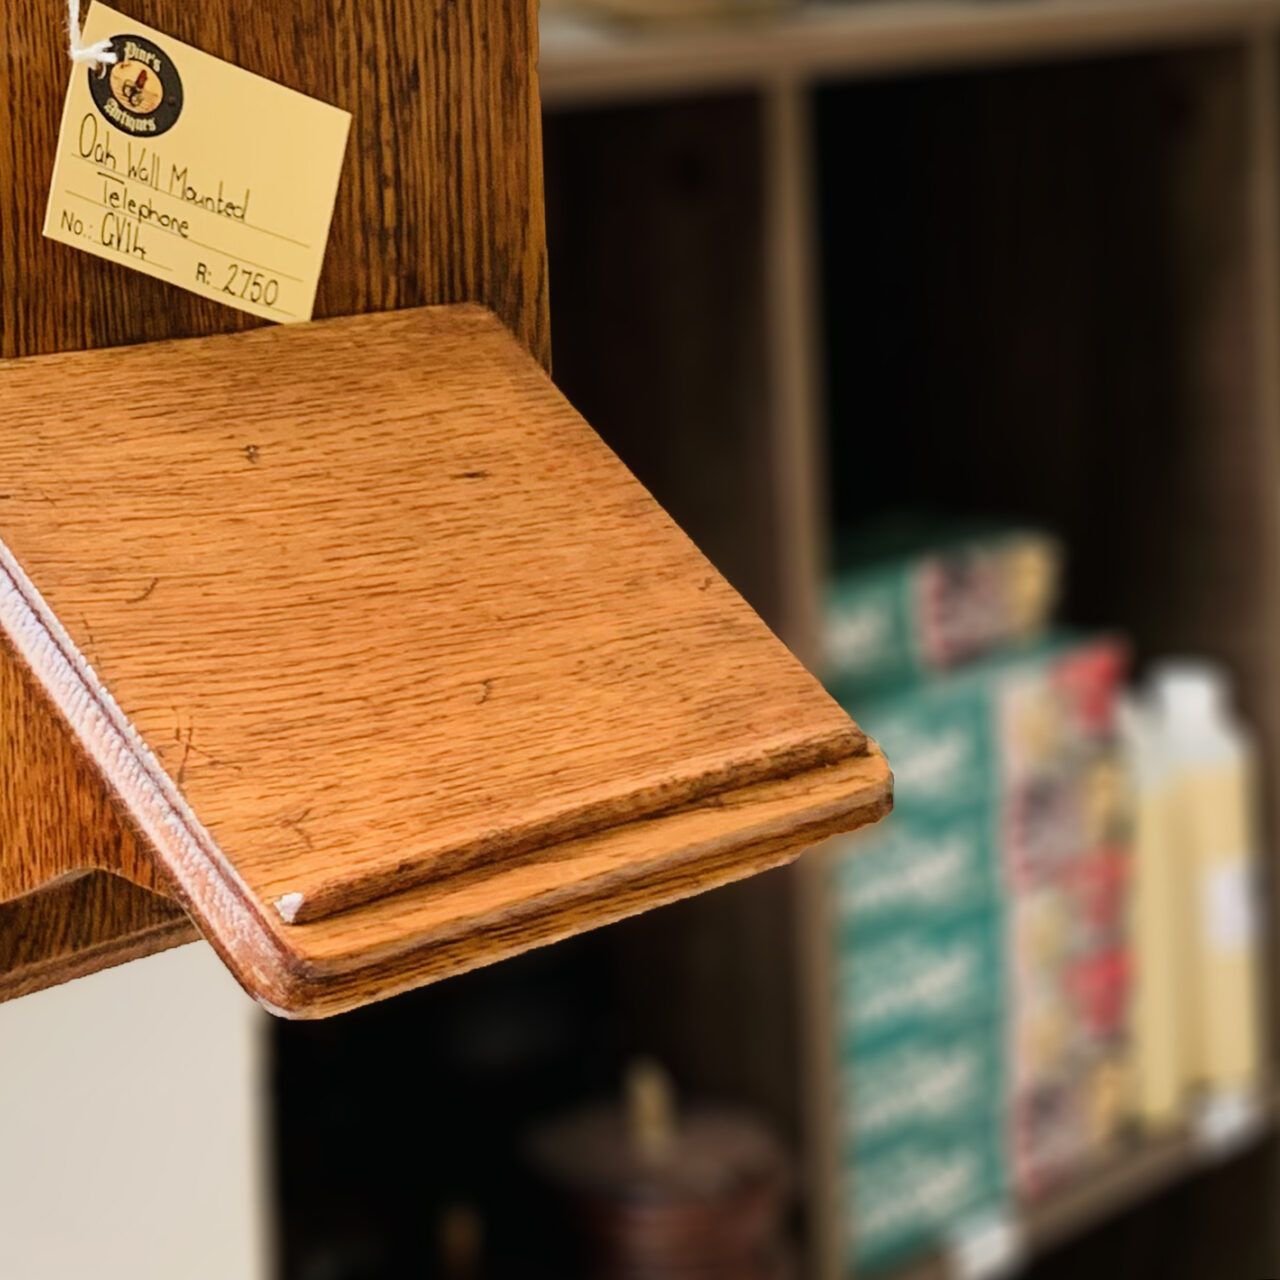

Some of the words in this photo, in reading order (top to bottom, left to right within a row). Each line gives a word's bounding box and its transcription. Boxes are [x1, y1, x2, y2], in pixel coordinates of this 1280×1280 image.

[124, 41, 161, 72] Pine's
[103, 97, 157, 132] Antiques
[128, 142, 160, 191] Wall
[169, 163, 250, 220] Mounted
[96, 171, 189, 238] Telephone
[196, 262, 212, 285] R:
[222, 263, 279, 306] 2750
